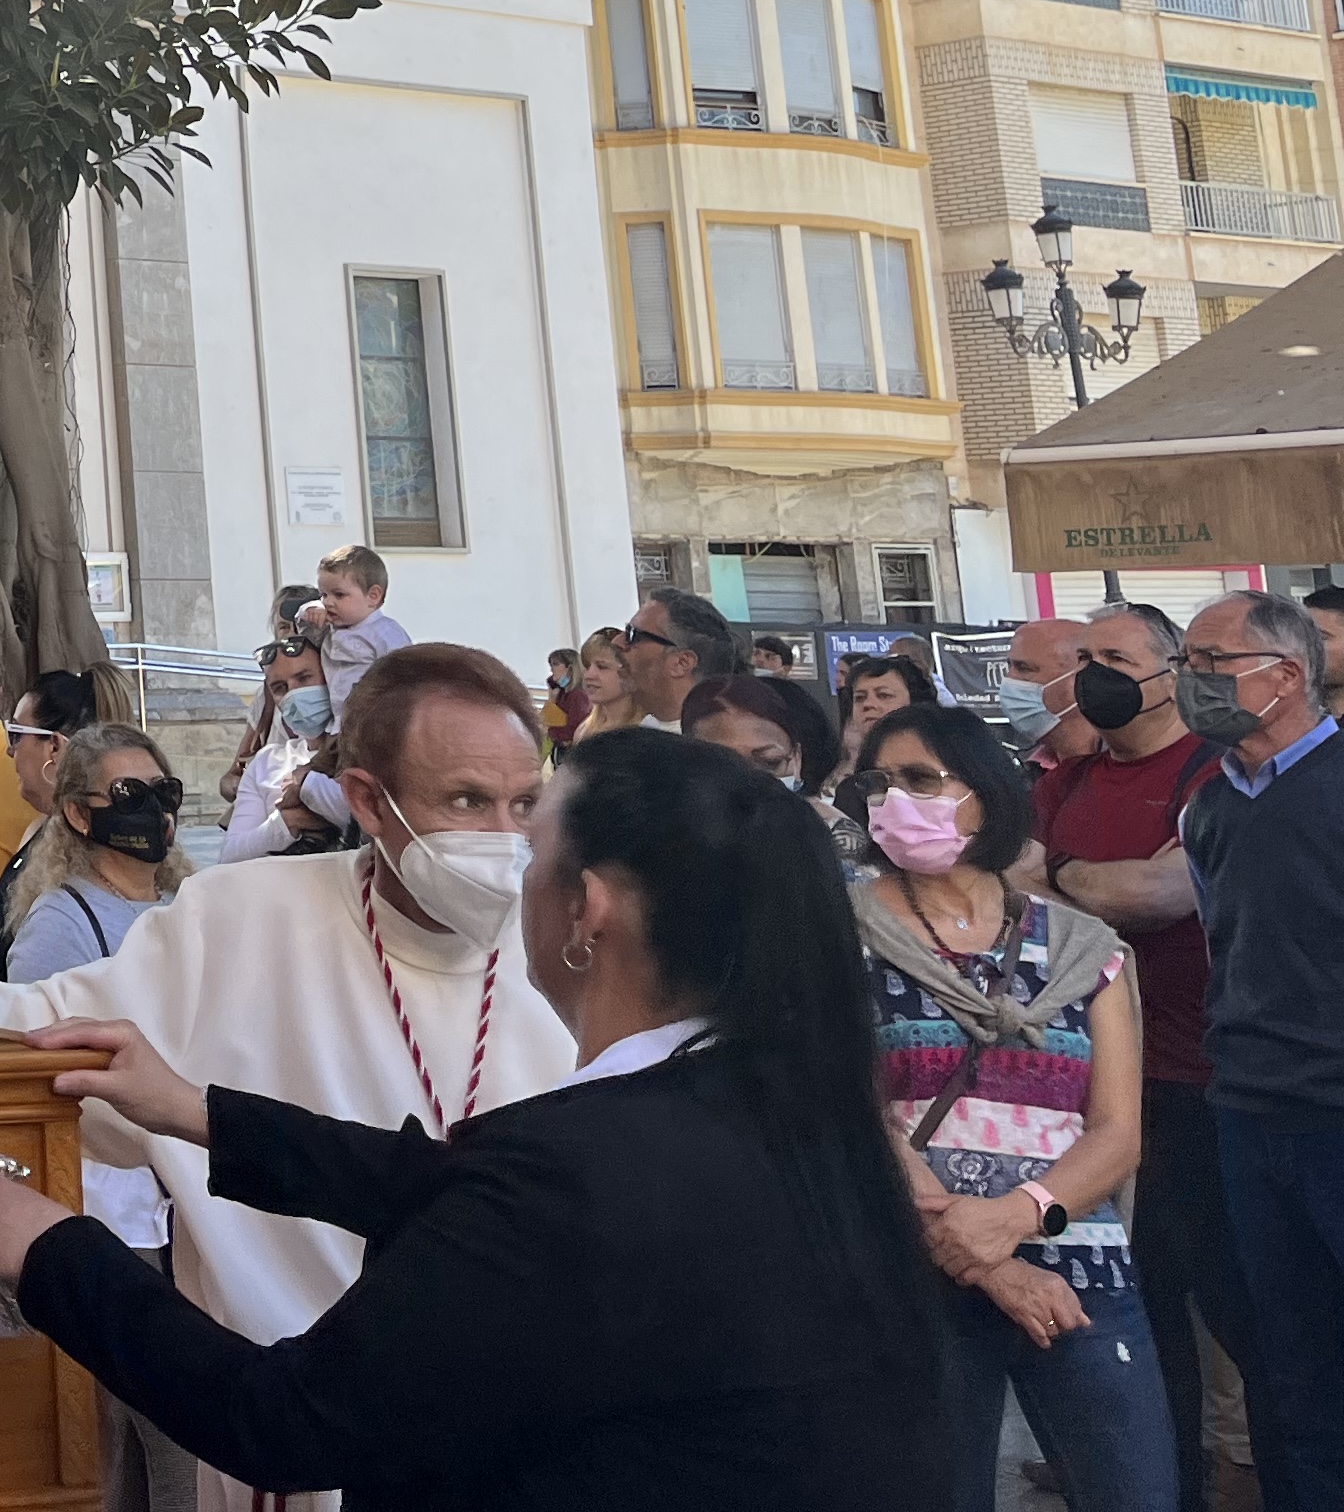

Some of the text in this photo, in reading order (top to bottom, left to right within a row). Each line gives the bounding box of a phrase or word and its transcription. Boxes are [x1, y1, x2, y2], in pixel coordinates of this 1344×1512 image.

[1063, 522, 1213, 548] ESTRELLA
[1100, 545, 1182, 558] DE LEVANTE
[831, 635, 849, 652] The
[849, 635, 878, 653] Room
